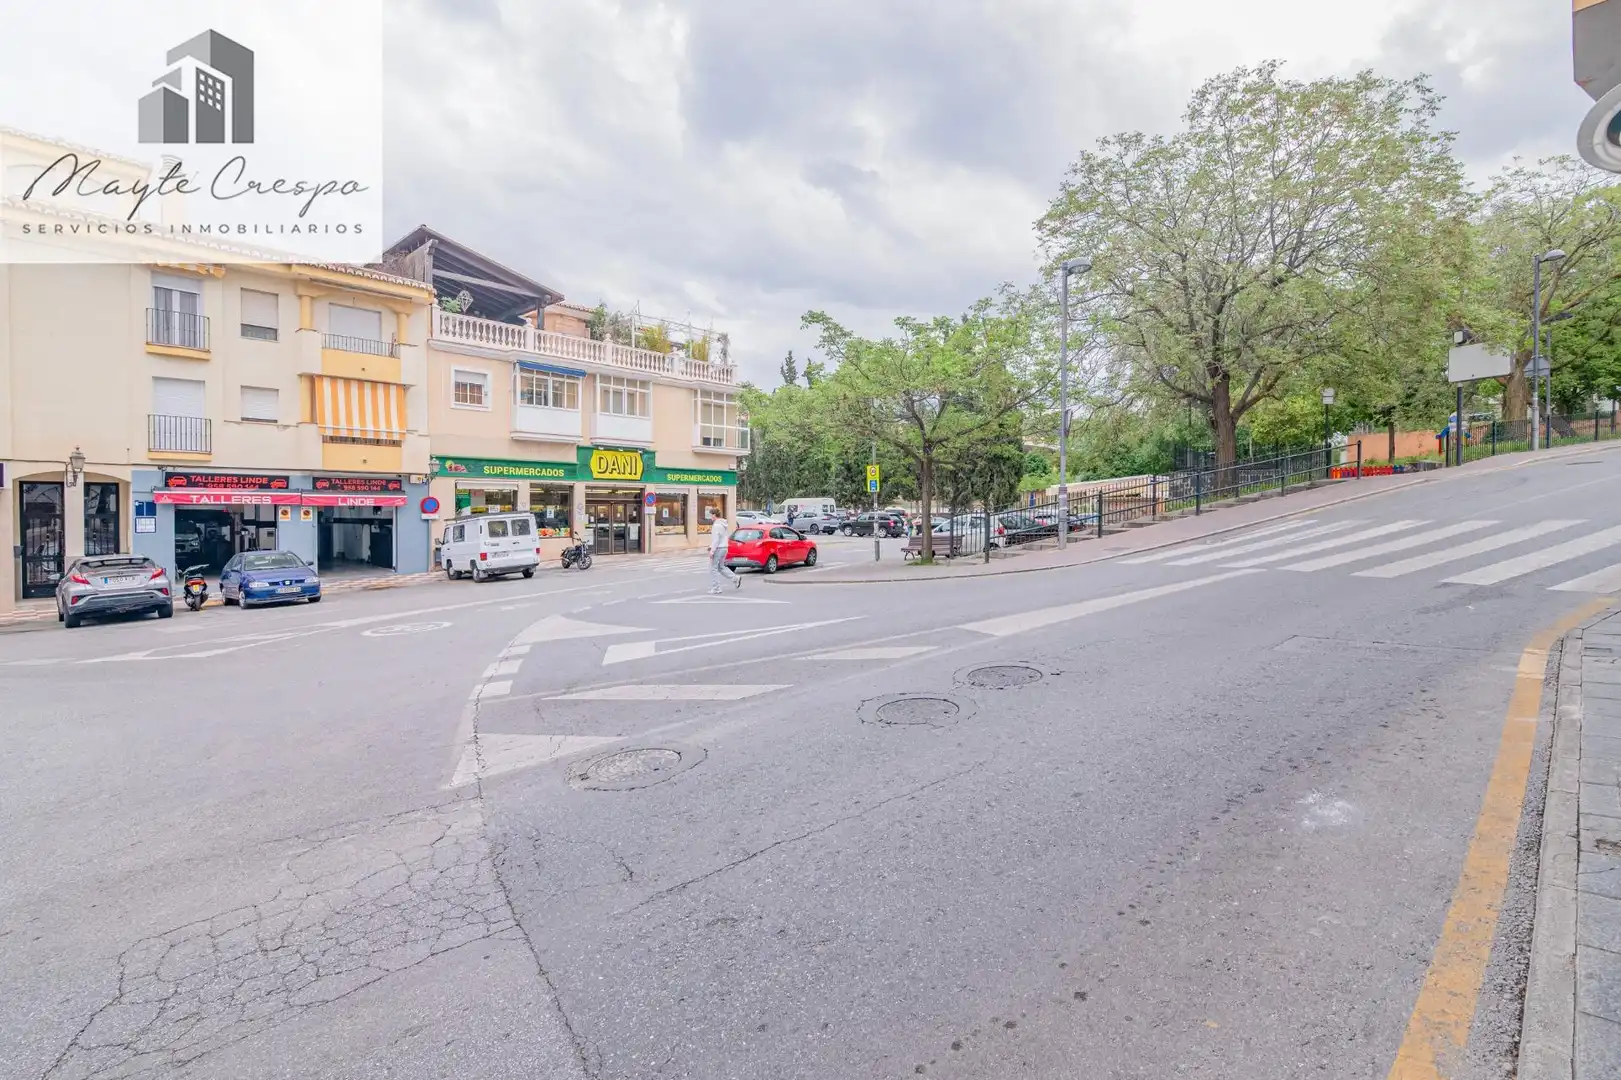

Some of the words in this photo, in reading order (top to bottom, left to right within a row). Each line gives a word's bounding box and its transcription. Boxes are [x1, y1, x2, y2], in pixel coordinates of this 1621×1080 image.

[597, 455, 638, 476] DANI
[483, 465, 565, 477] SUPERMERCADOS
[190, 475, 238, 483] TALLERES
[331, 478, 365, 486] TALLERES
[666, 473, 723, 483] SUPERMERCADOS
[189, 495, 272, 504] TALLERES
[338, 498, 375, 506] LINDE
